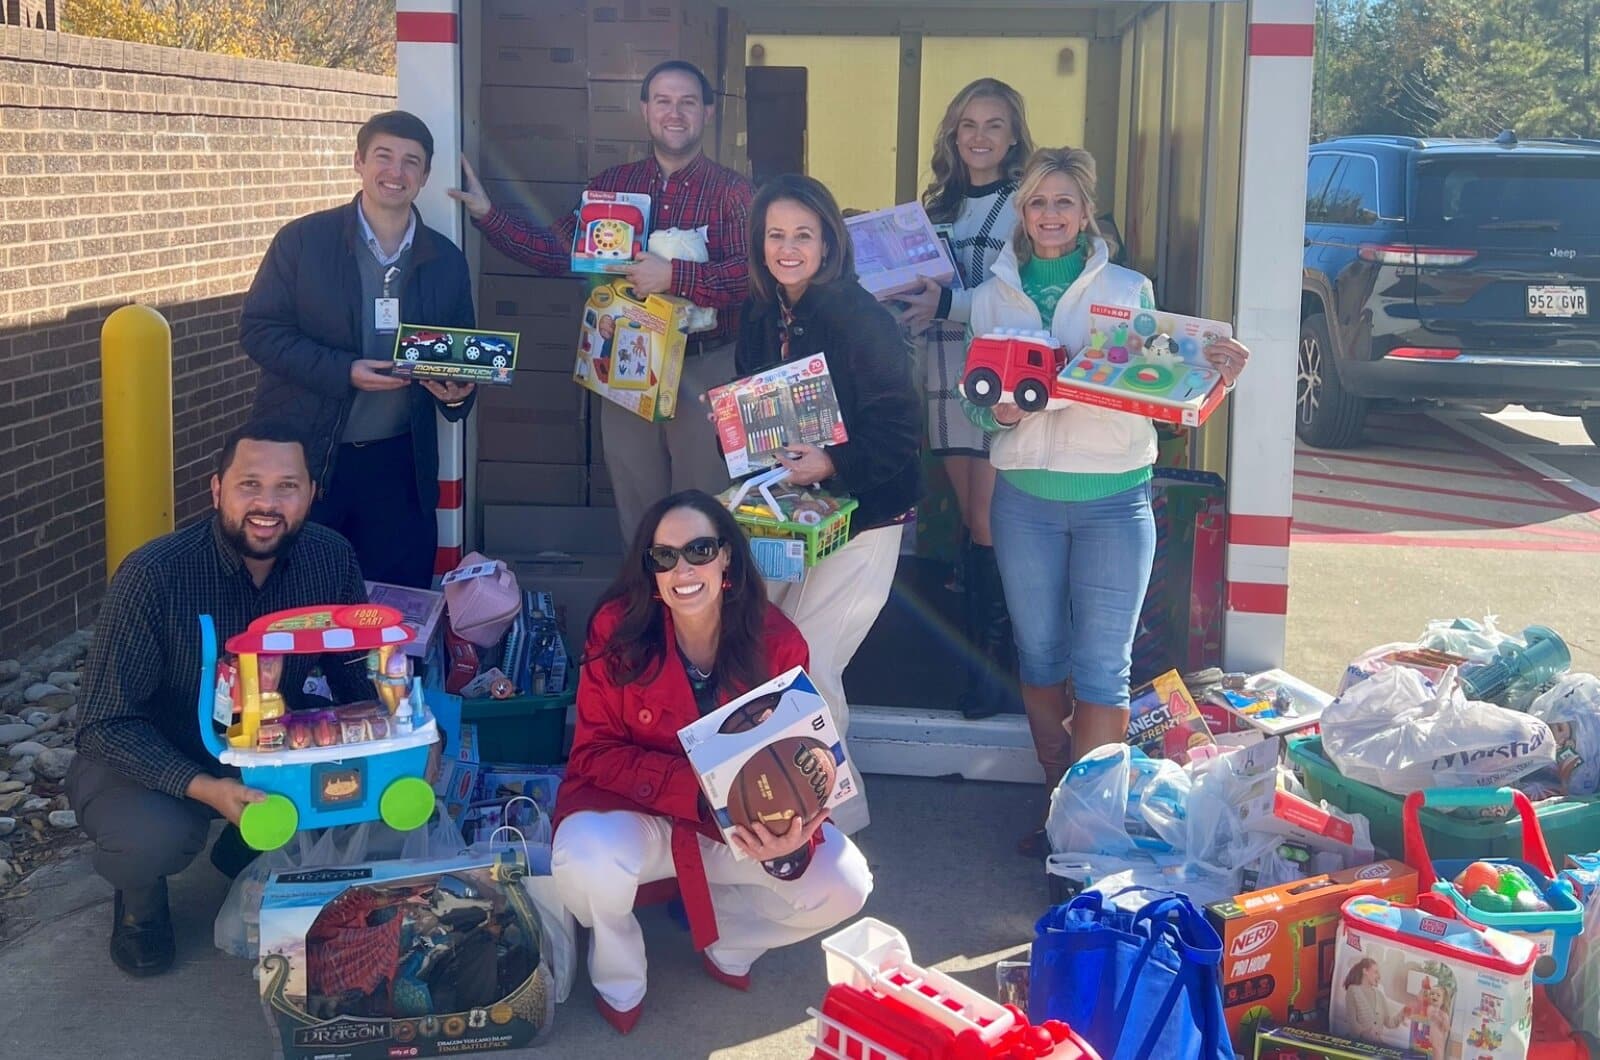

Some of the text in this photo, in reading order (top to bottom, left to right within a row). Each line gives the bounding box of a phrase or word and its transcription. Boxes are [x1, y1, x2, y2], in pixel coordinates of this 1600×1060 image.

[1549, 247, 1577, 259] Jeep
[1529, 295, 1584, 309] 952 GVR
[414, 363, 461, 374] MONSTER
[462, 367, 494, 376] TRUCK
[354, 608, 378, 618] FOOD
[359, 616, 383, 626] CART
[1169, 690, 1191, 717] 4
[1127, 704, 1171, 737] NNECT
[1142, 715, 1180, 741] FRENZY
[793, 742, 828, 806] Wilson
[1231, 922, 1275, 954] NERF
[1230, 953, 1272, 978] PRO HOOP
[303, 1024, 385, 1043] DRAGON
[1282, 1026, 1403, 1056] MONSTER TRUCK
